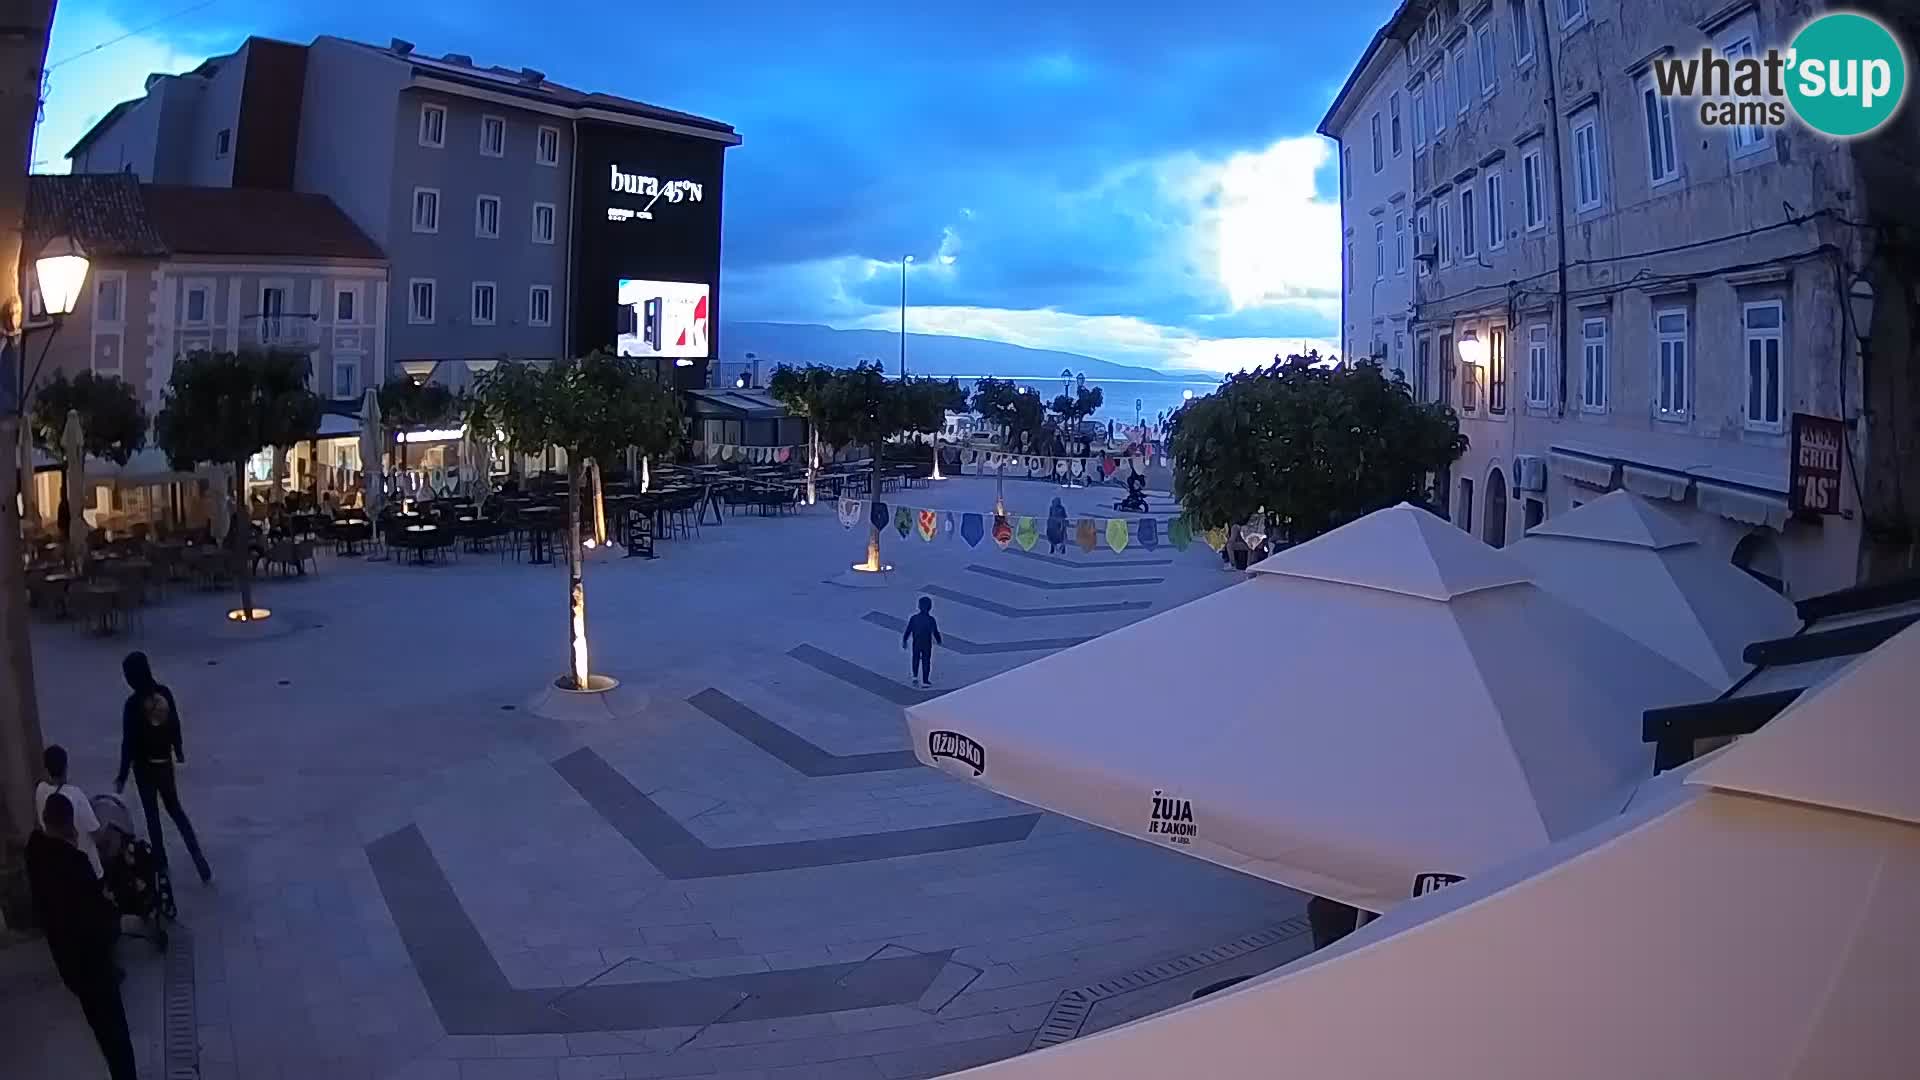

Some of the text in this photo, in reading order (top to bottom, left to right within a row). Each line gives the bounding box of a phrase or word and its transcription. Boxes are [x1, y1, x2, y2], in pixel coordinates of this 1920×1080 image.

[611, 164, 659, 197] bura
[1799, 447, 1839, 471] GRILL
[1151, 790, 1193, 823] ŽUJA
[1148, 820, 1159, 833] JE
